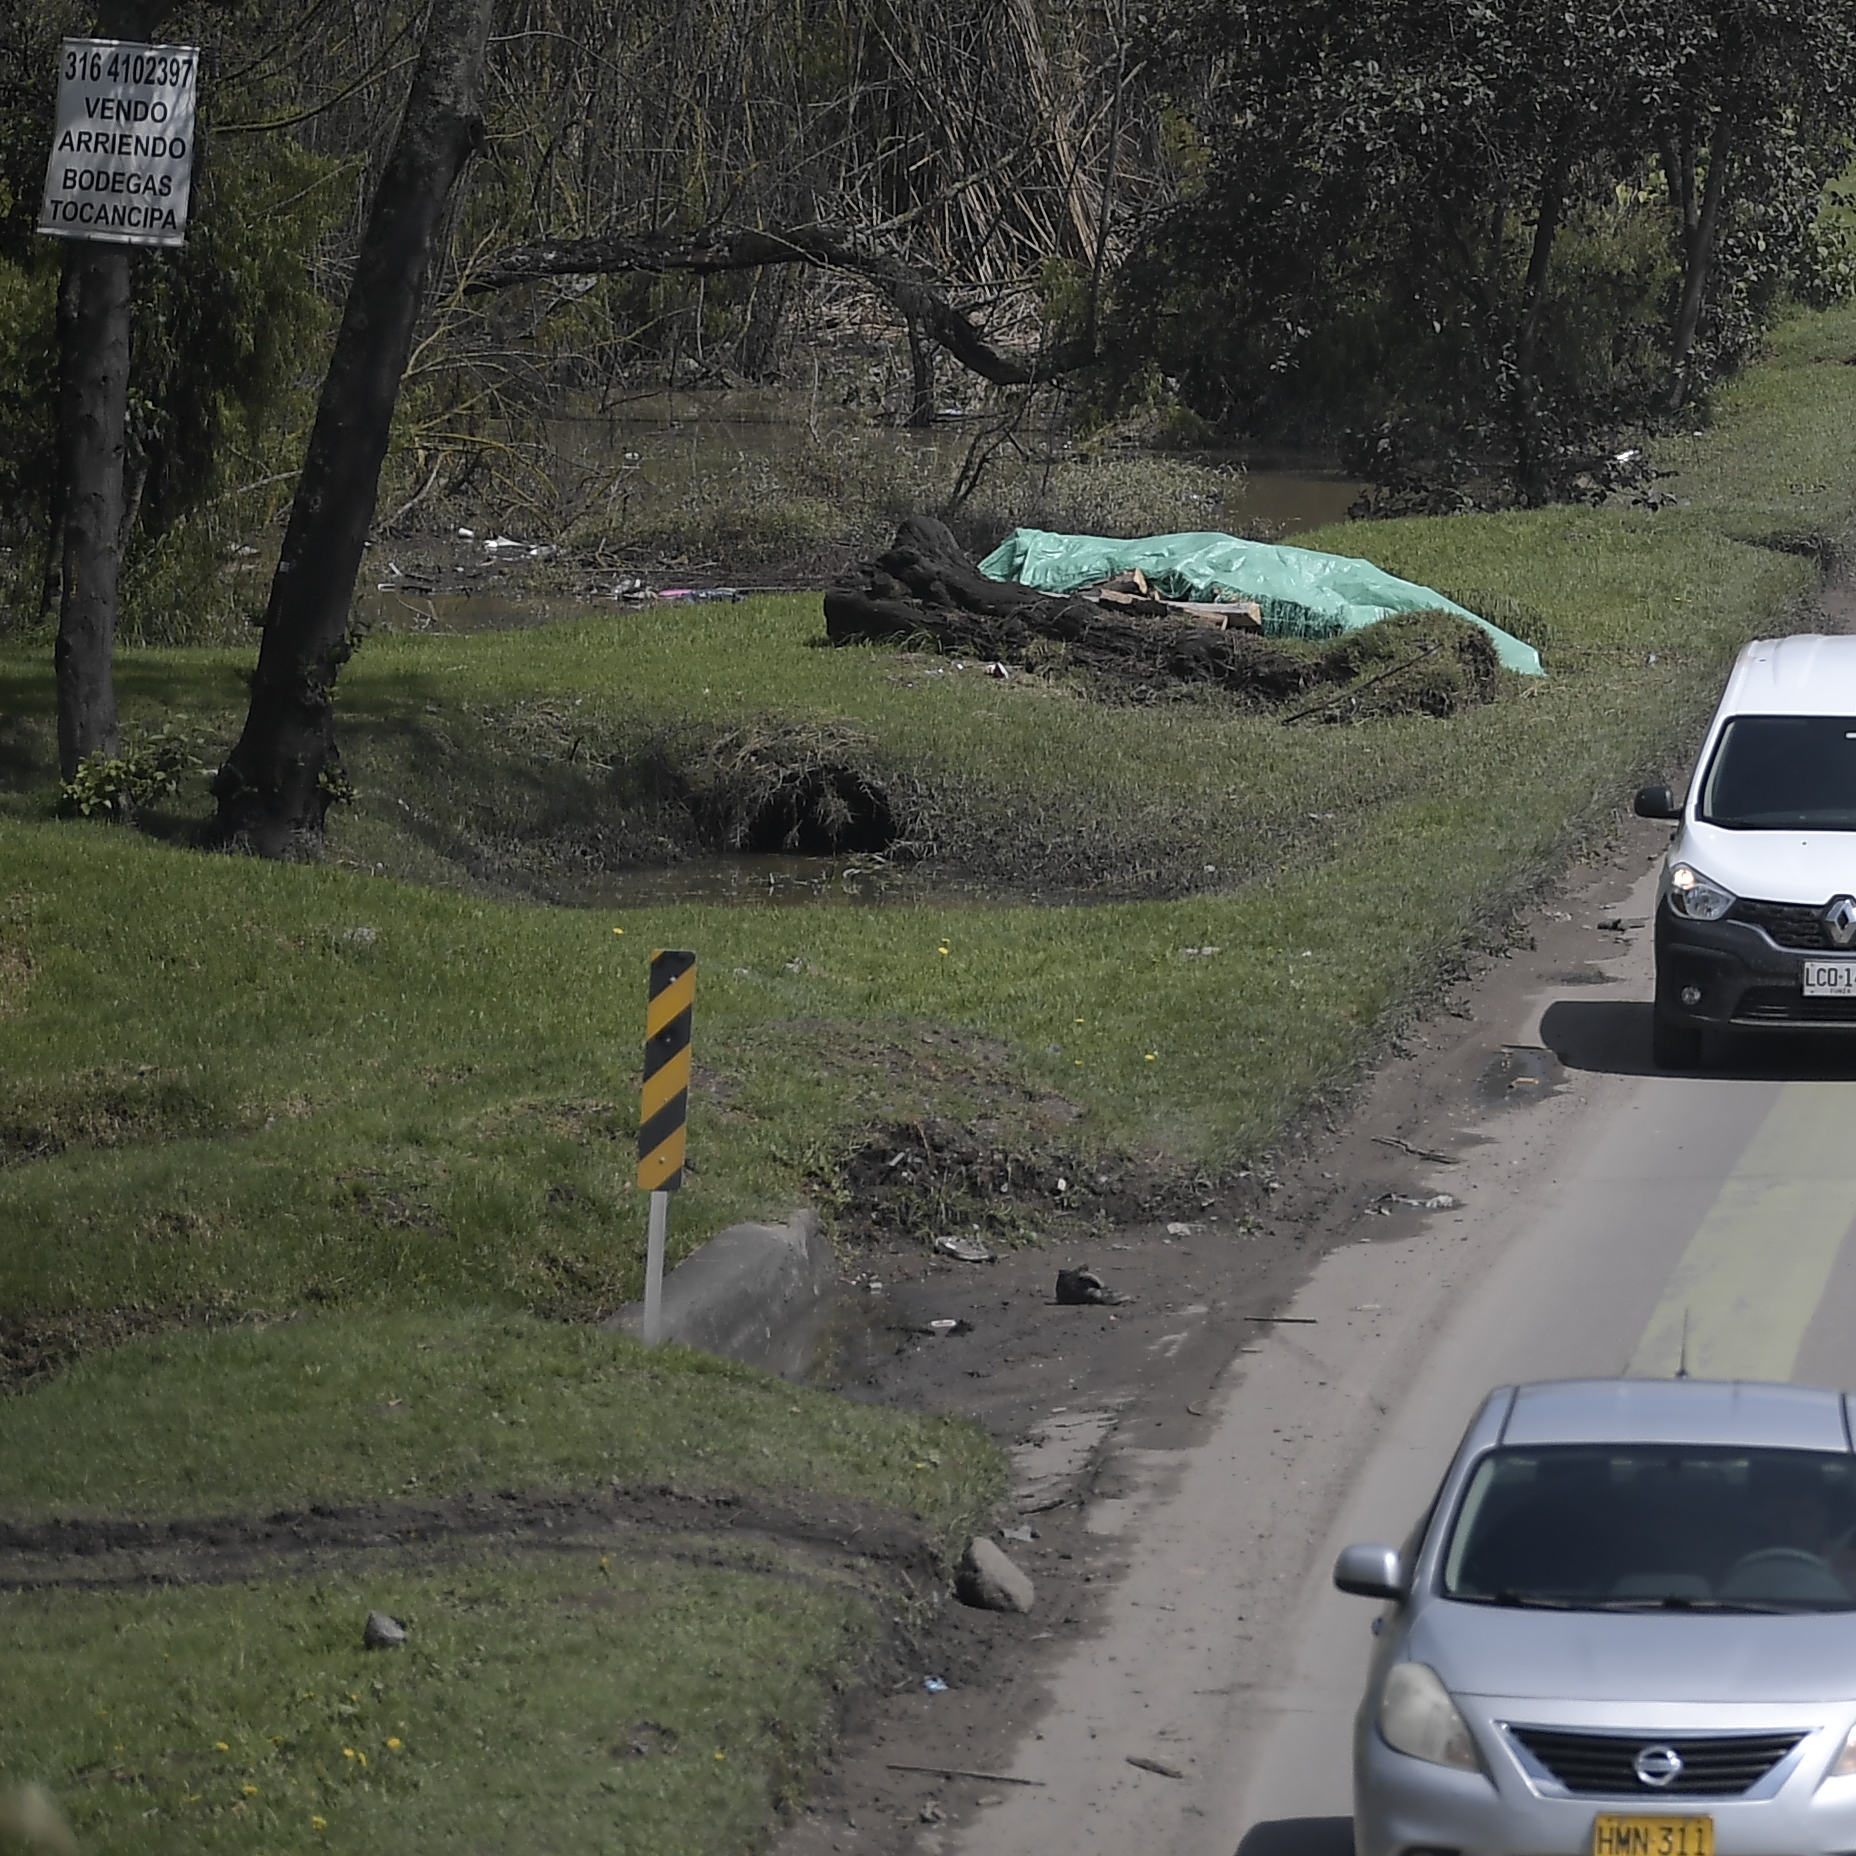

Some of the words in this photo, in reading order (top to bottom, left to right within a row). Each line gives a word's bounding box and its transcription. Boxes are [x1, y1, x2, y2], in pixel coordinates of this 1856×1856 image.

[65, 51, 101, 81] 316
[107, 53, 193, 88] 4102397
[85, 97, 168, 123] VENDO
[58, 130, 186, 159] ARRIENDO
[62, 168, 173, 196] BODEGAS
[50, 199, 177, 229] TOCANCIPA
